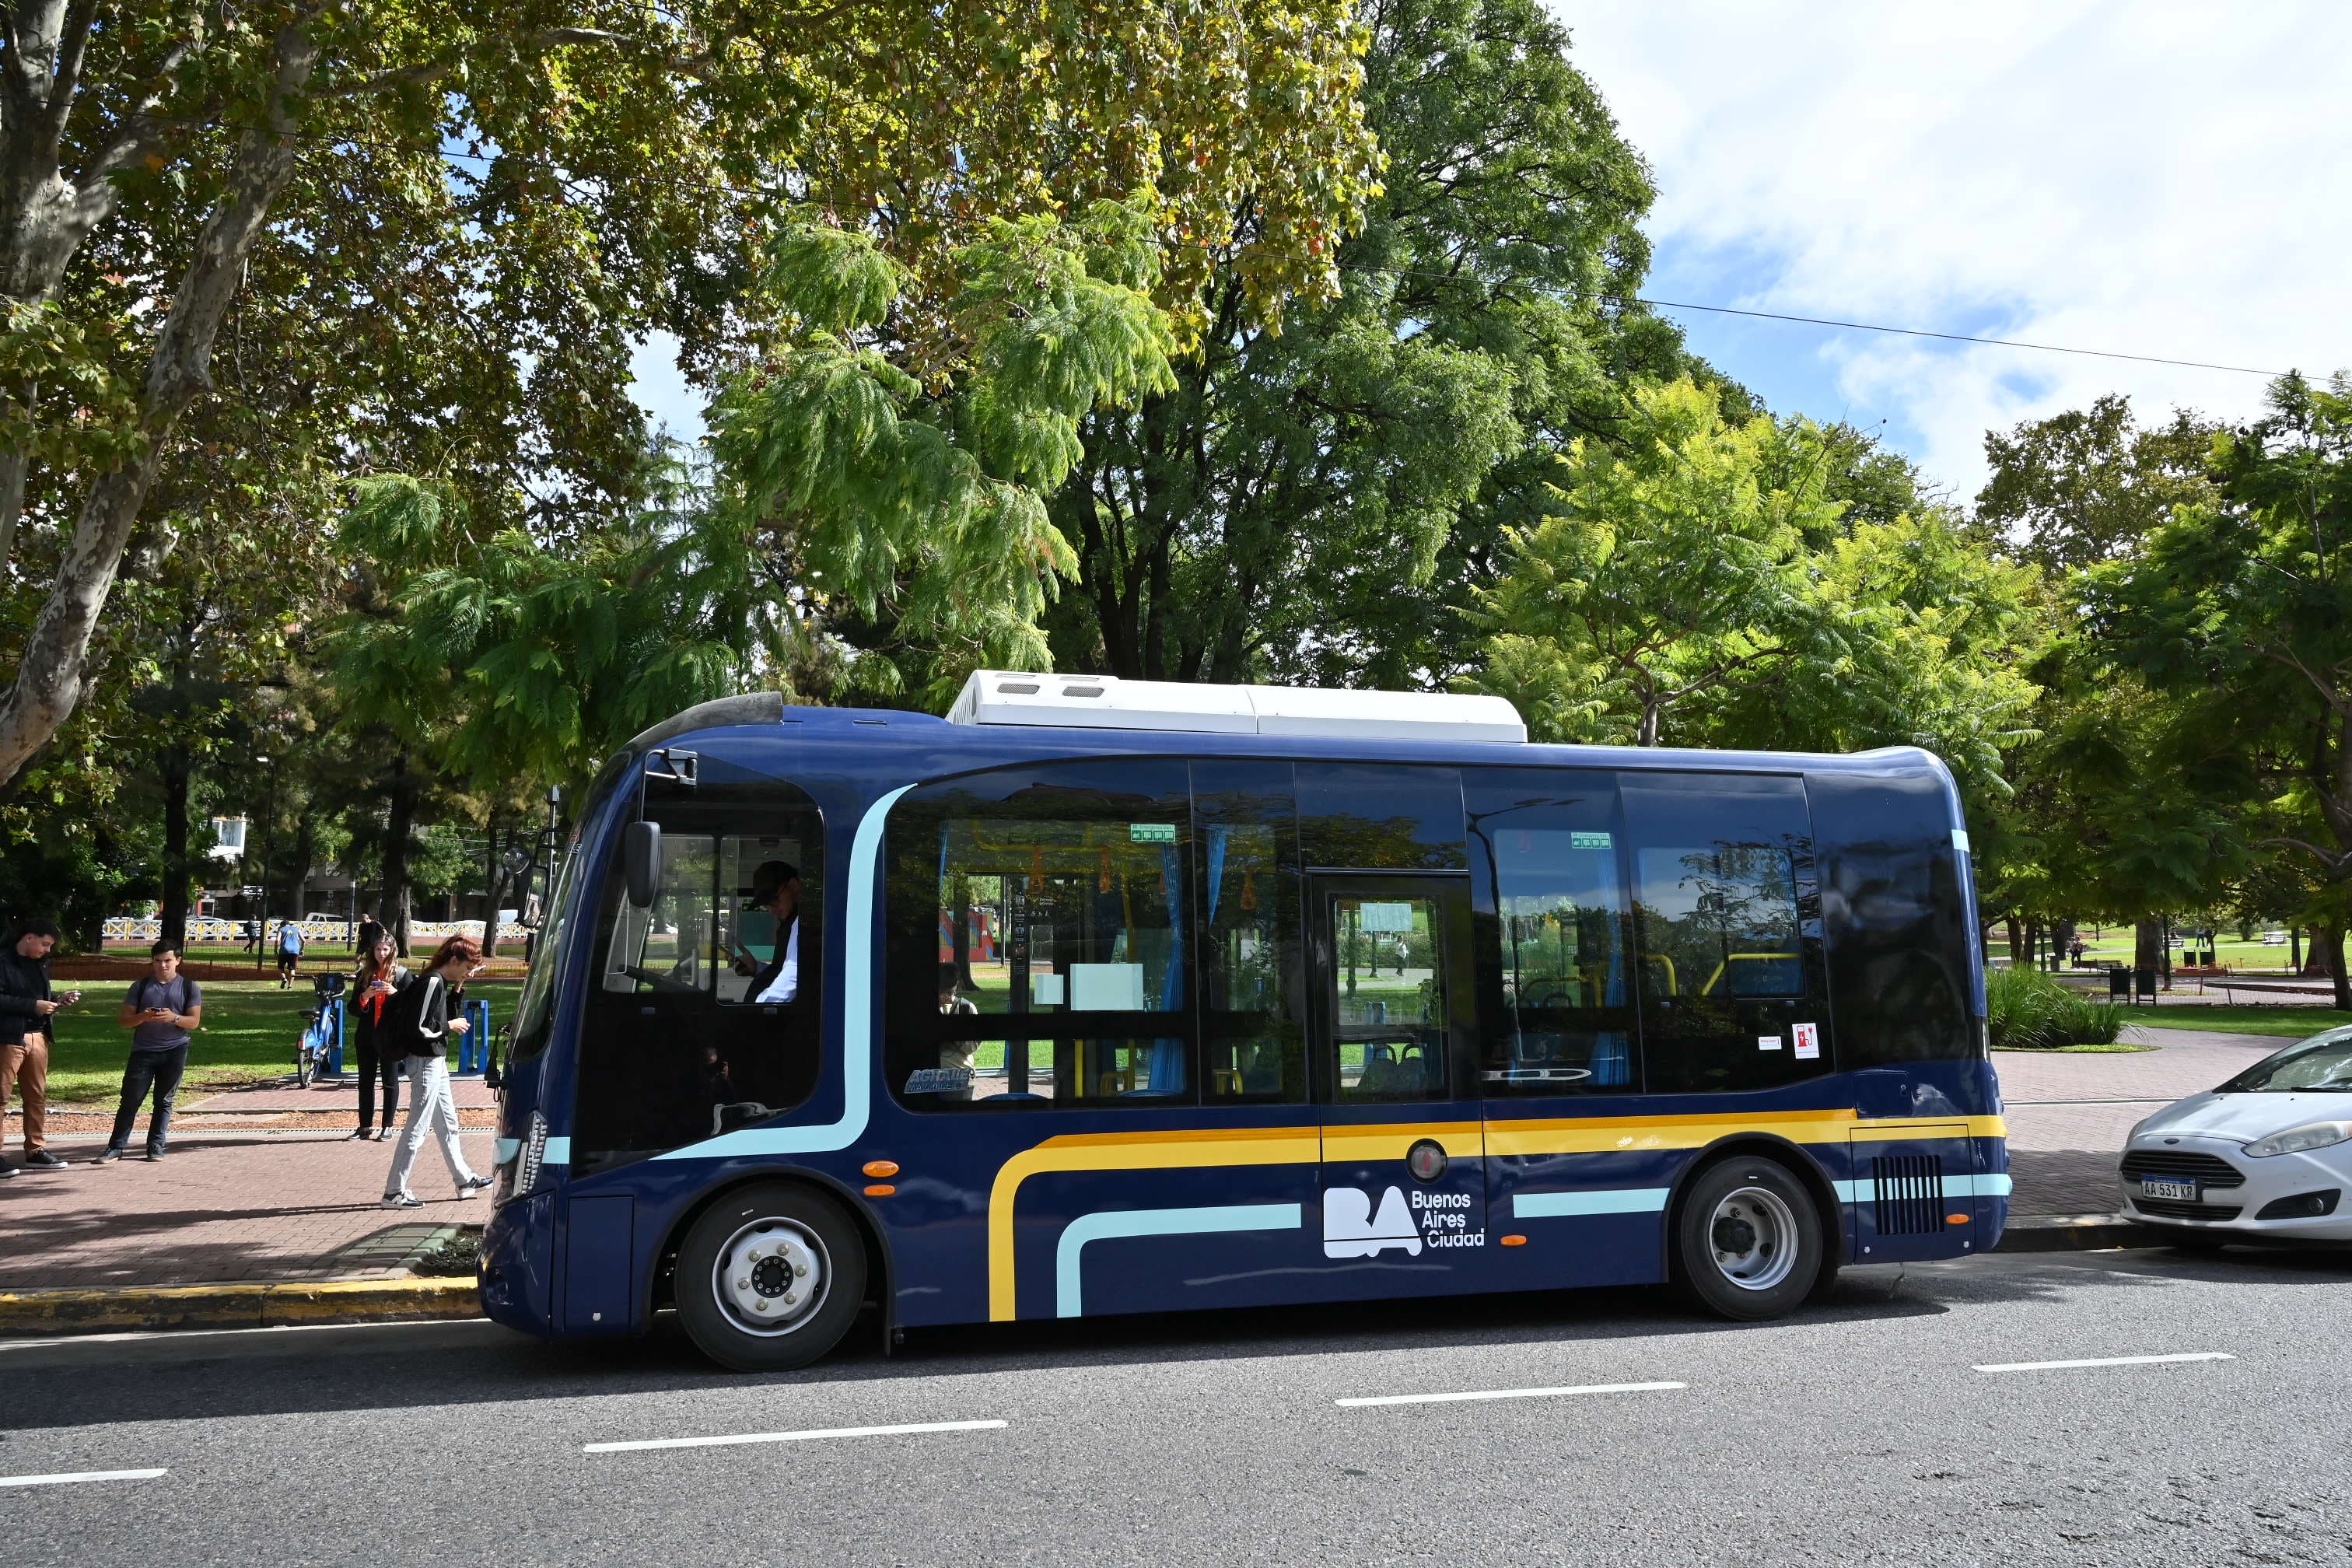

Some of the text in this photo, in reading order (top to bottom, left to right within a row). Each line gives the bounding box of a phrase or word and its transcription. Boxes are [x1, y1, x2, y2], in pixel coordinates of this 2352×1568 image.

[1412, 1191, 1471, 1209] Buenos
[2144, 1182, 2193, 1199] AA 531 KR
[1324, 1185, 1422, 1258] BA
[1422, 1210, 1466, 1229] Aires
[1427, 1228, 1485, 1248] Ciudad
